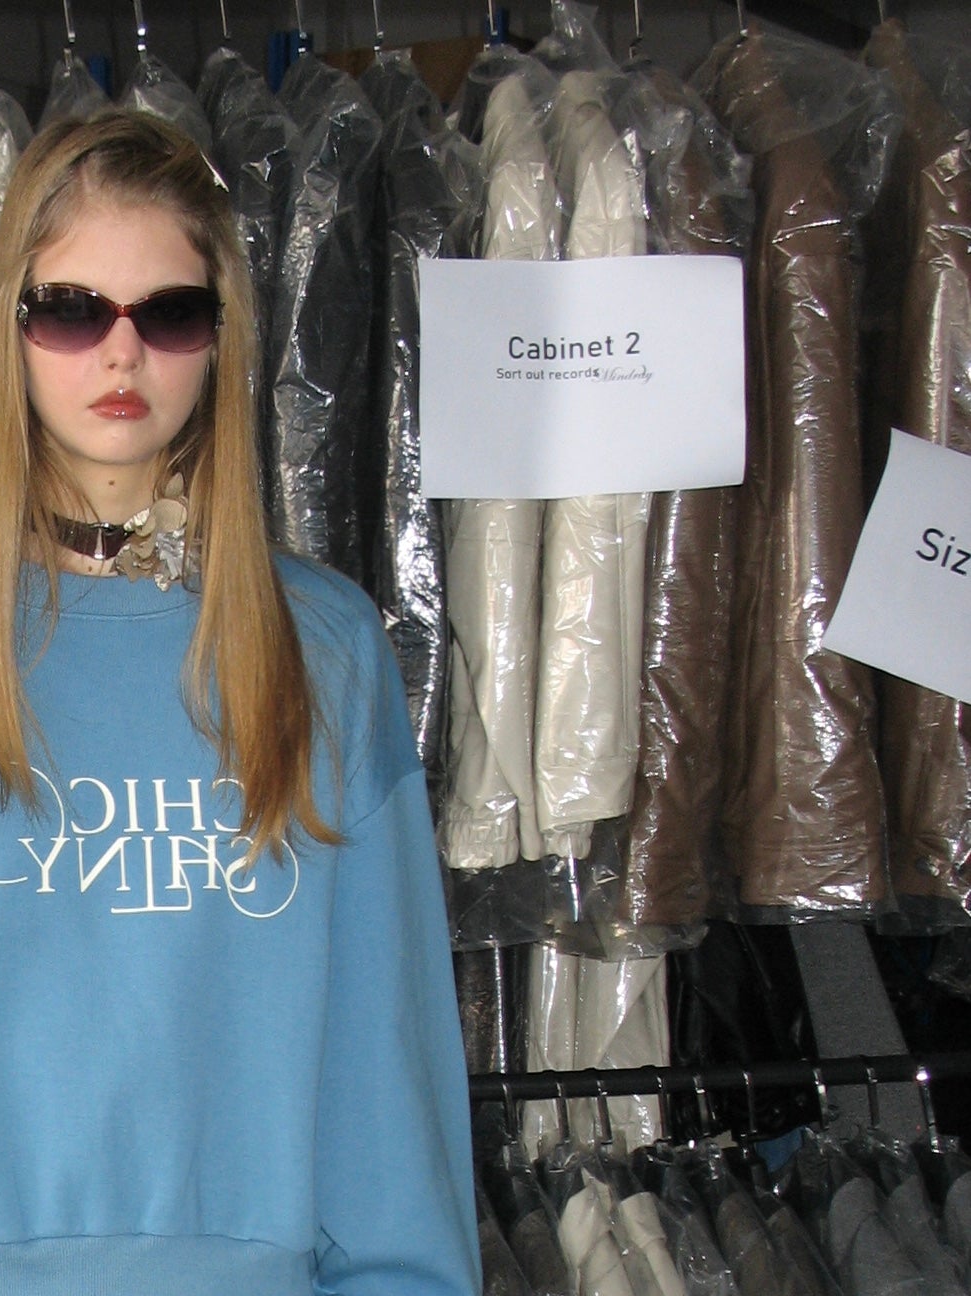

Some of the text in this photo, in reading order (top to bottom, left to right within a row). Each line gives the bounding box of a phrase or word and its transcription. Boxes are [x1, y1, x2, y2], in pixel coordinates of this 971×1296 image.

[508, 331, 641, 360] Cabinet 2
[496, 366, 600, 380] Sort out records
[915, 527, 971, 576] Siz
